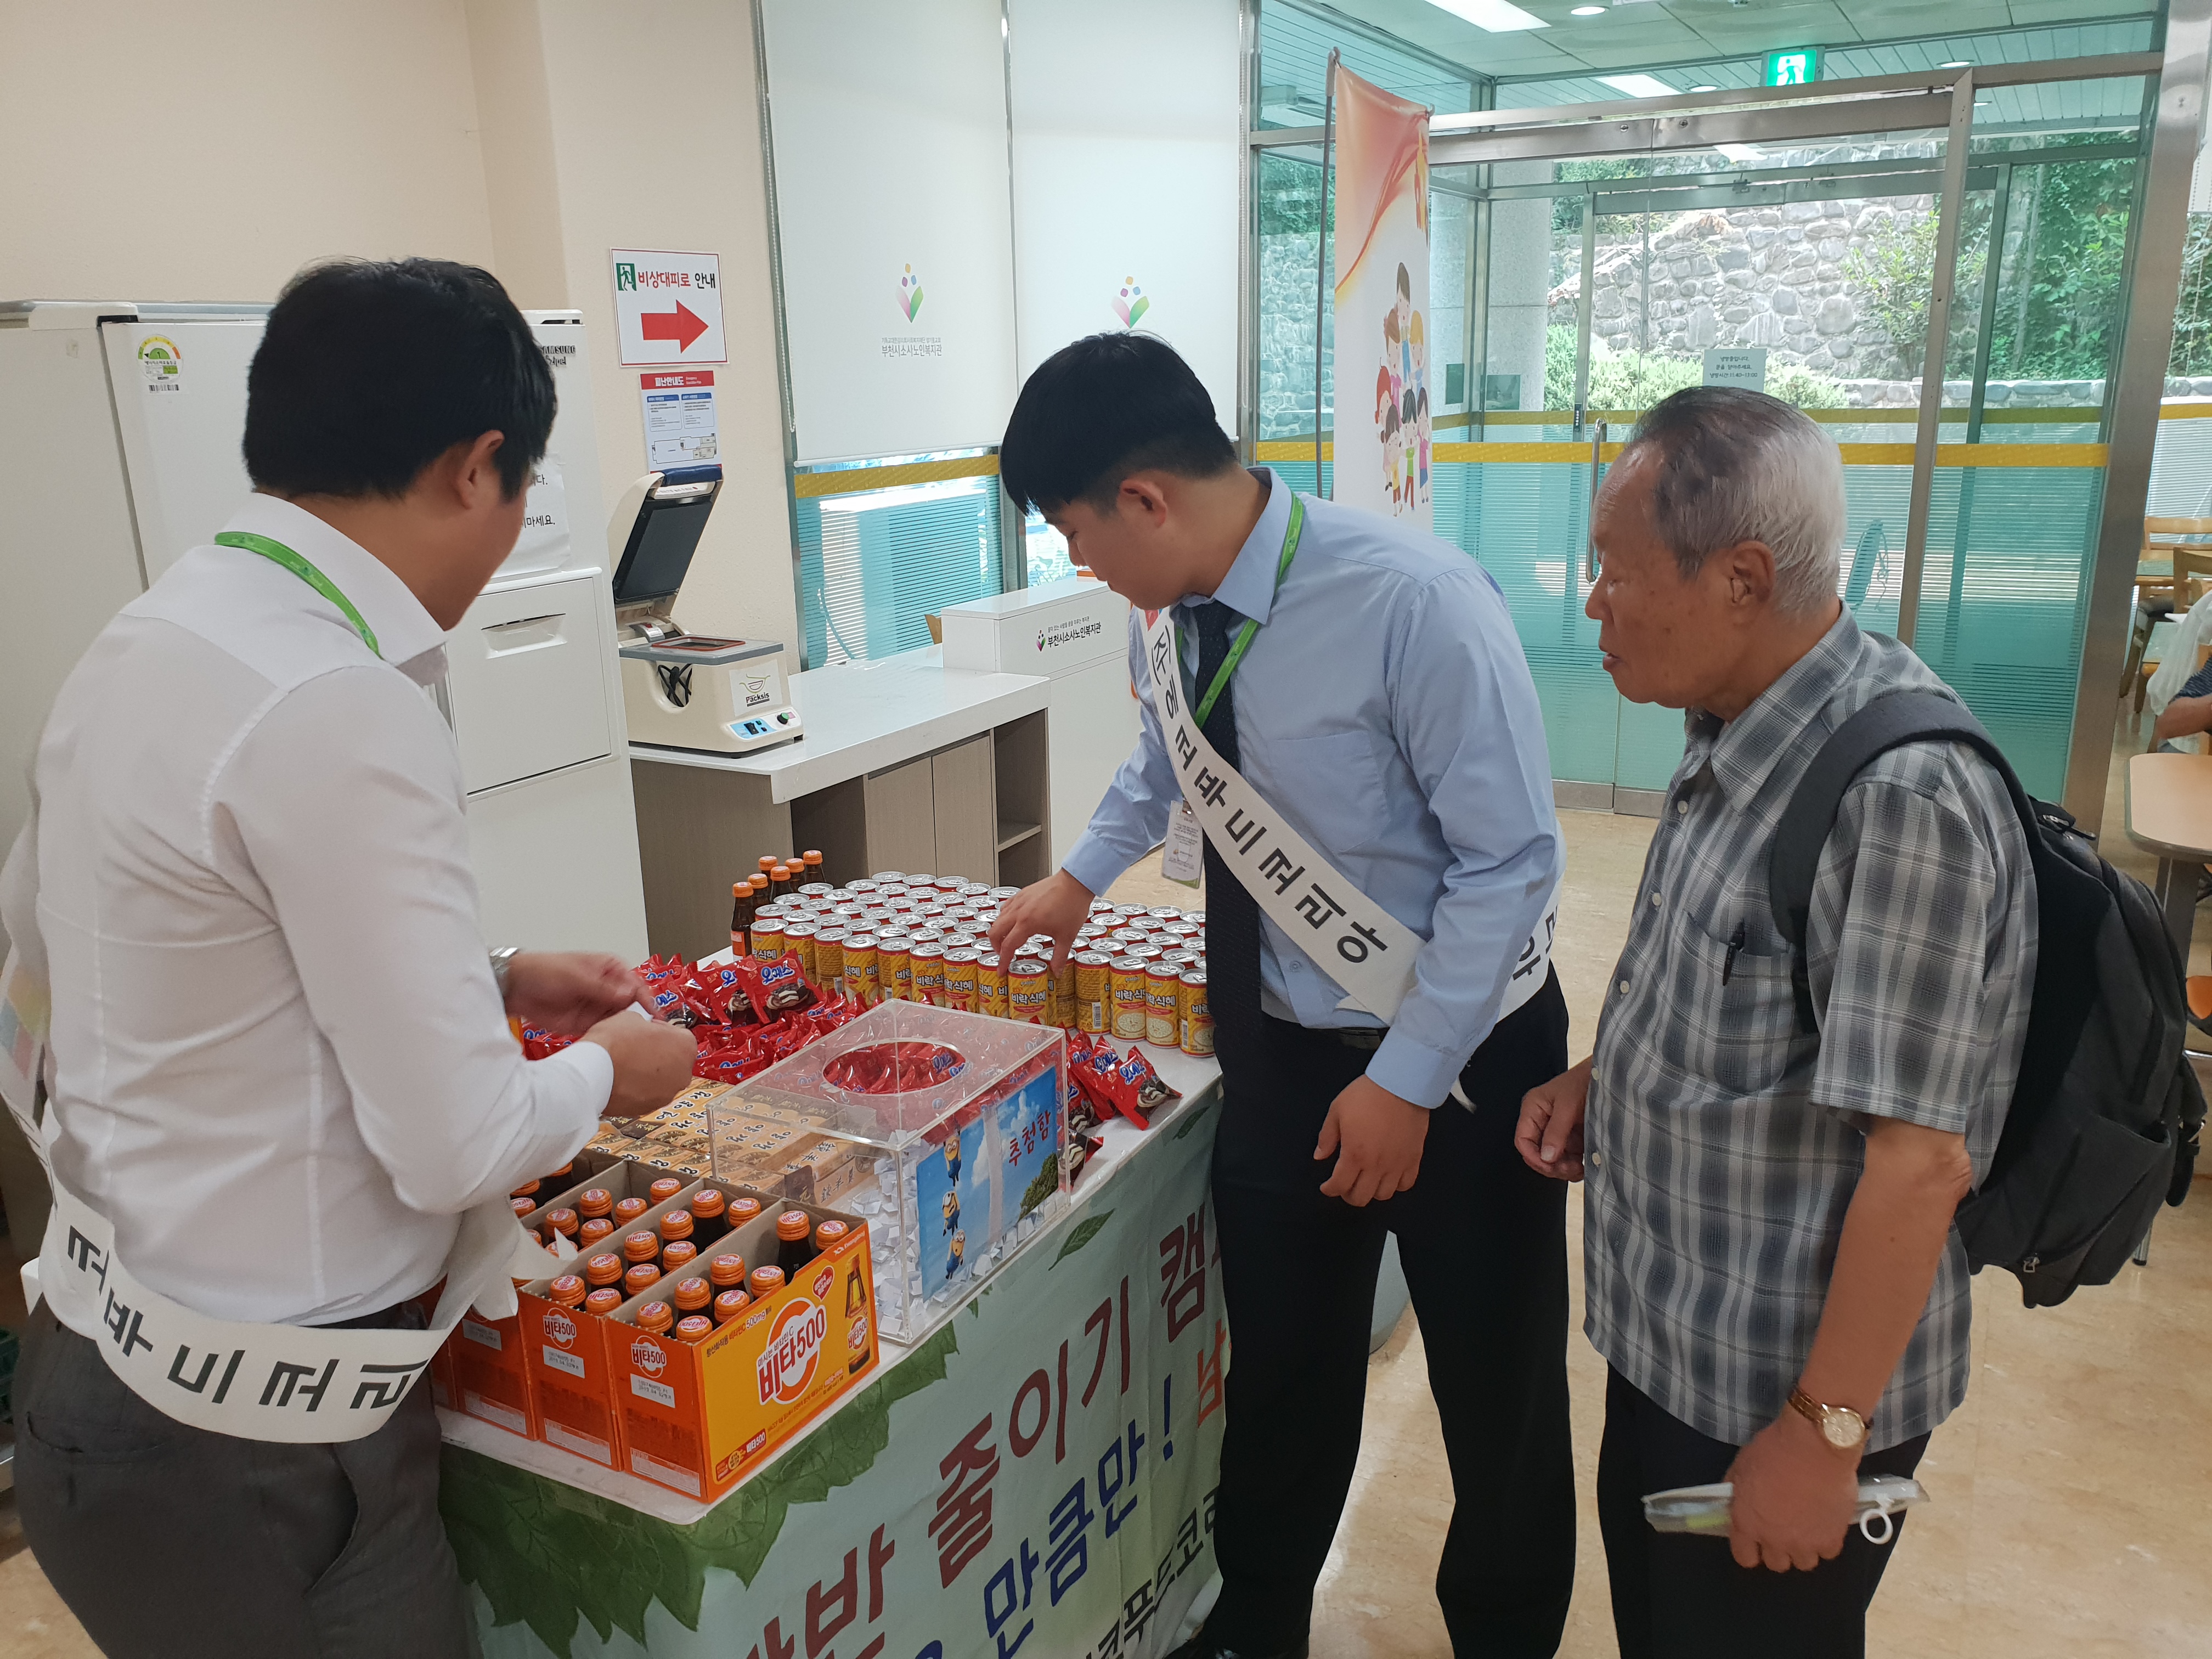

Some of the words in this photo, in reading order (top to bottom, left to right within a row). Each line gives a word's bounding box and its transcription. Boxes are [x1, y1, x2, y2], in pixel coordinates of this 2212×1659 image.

[638, 272, 691, 288] 비상대피로
[695, 273, 715, 289] 안내
[882, 345, 942, 357] 부천시소사노인복지관
[1048, 622, 1101, 648] 부천시소사노인복지관
[746, 692, 770, 703] Packsis
[761, 966, 795, 985] 오예스
[655, 990, 679, 1007] 예스
[1119, 1060, 1146, 1085] 오예스
[1008, 1109, 1052, 1167] 추첨함
[587, 1290, 617, 1300] 비타500
[544, 1320, 576, 1338] 비타500
[706, 1334, 729, 1357] 항산화작용
[746, 1311, 766, 1329] 500mg
[848, 1318, 868, 1349] 비타500
[633, 1348, 665, 1365] 비타500
[758, 1349, 774, 1367] 마시는
[759, 1308, 825, 1403] 비타500
[928, 1275, 1130, 1589] 줄이기
[746, 1431, 766, 1453] 비타500
